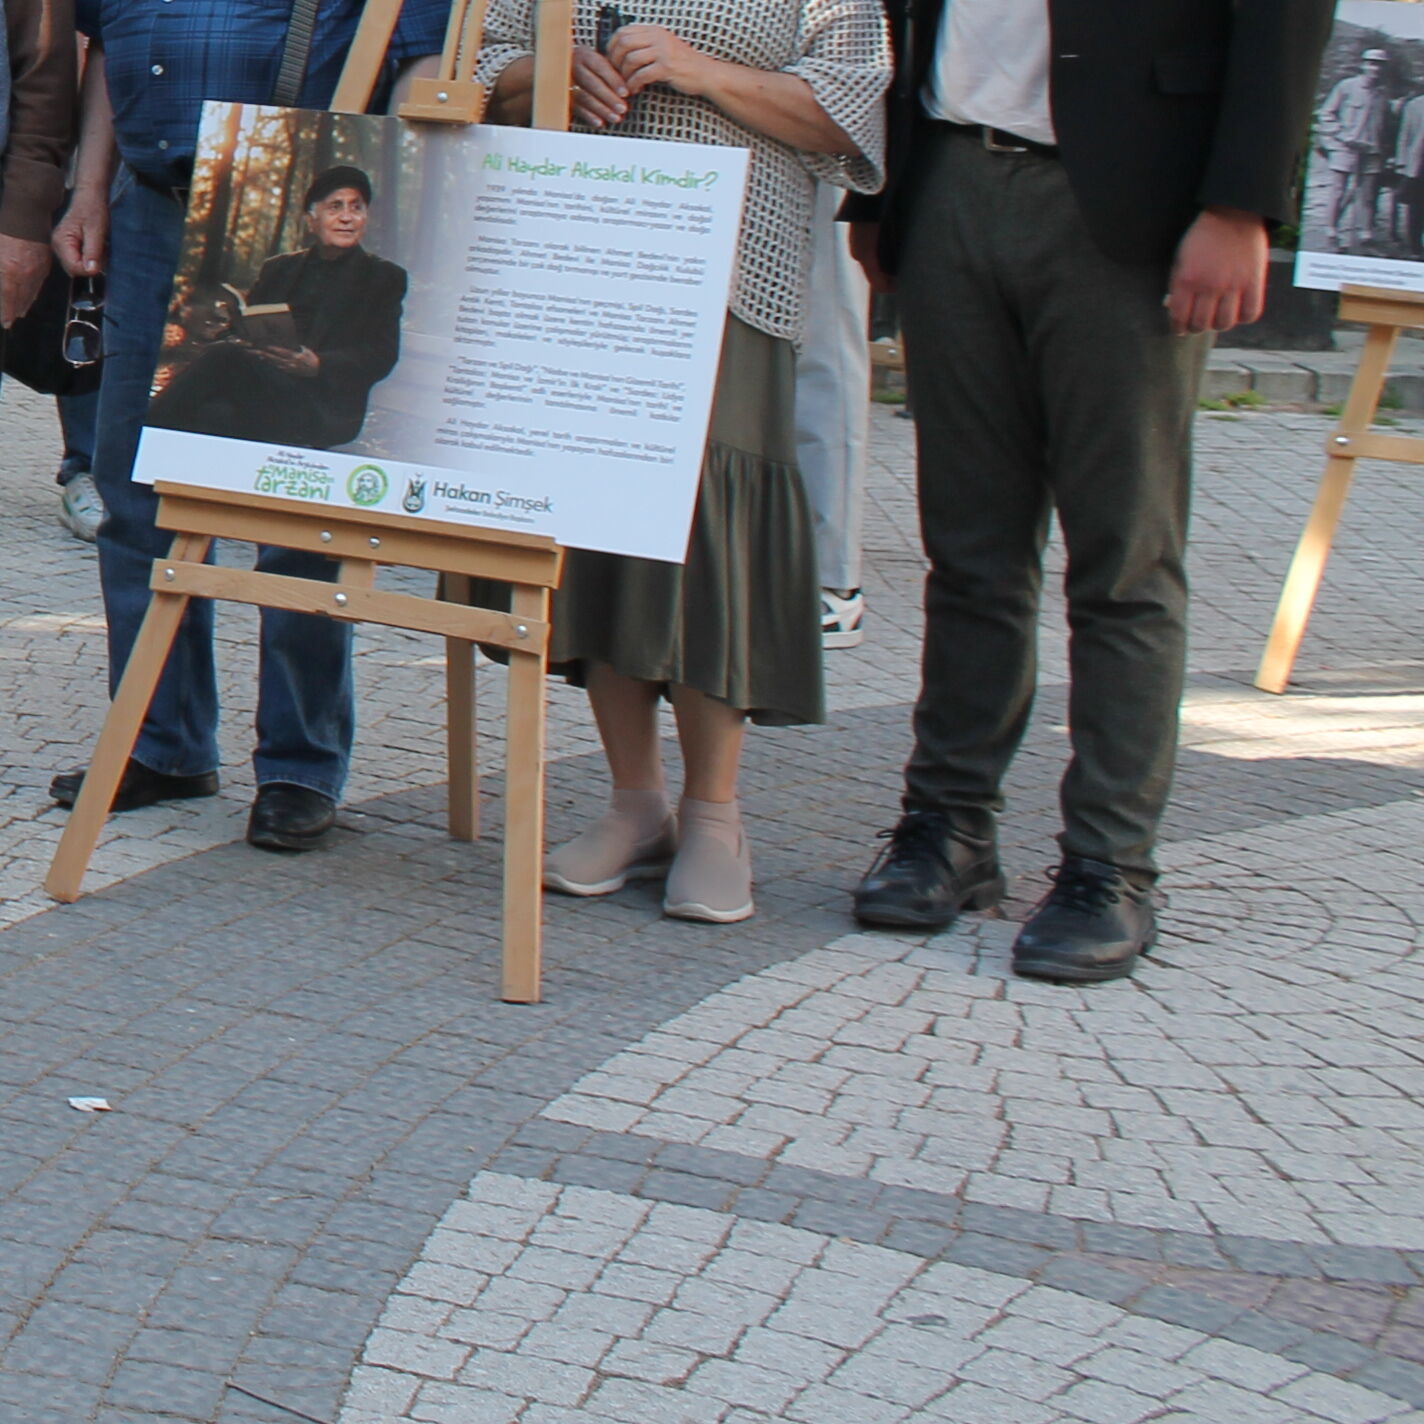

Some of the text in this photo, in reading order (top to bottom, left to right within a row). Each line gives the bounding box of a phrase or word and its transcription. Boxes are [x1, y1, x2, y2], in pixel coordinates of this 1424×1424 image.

[482, 153, 502, 172] Ali
[507, 157, 567, 180] Haydar
[571, 161, 637, 184] Aksakal
[433, 479, 554, 514] Hakan Şimşek
